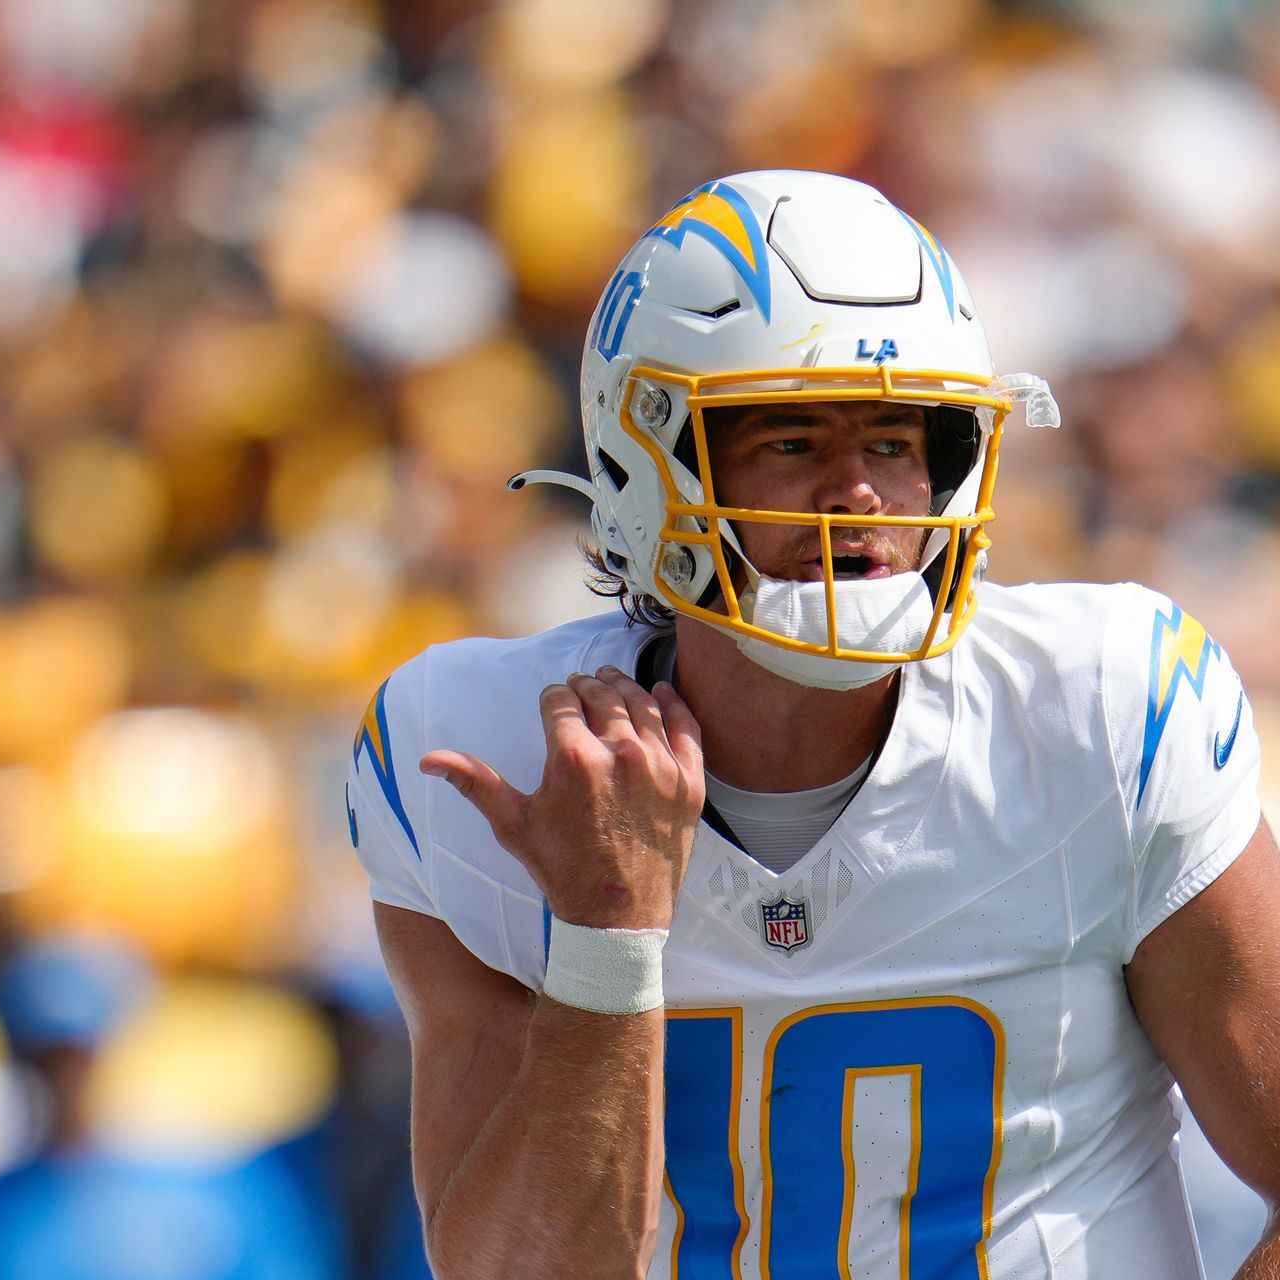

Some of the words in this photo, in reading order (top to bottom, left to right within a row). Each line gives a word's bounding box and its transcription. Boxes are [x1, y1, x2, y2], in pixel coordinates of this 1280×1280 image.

[590, 269, 649, 363] 10
[854, 338, 900, 367] LA
[767, 920, 805, 945] NFL
